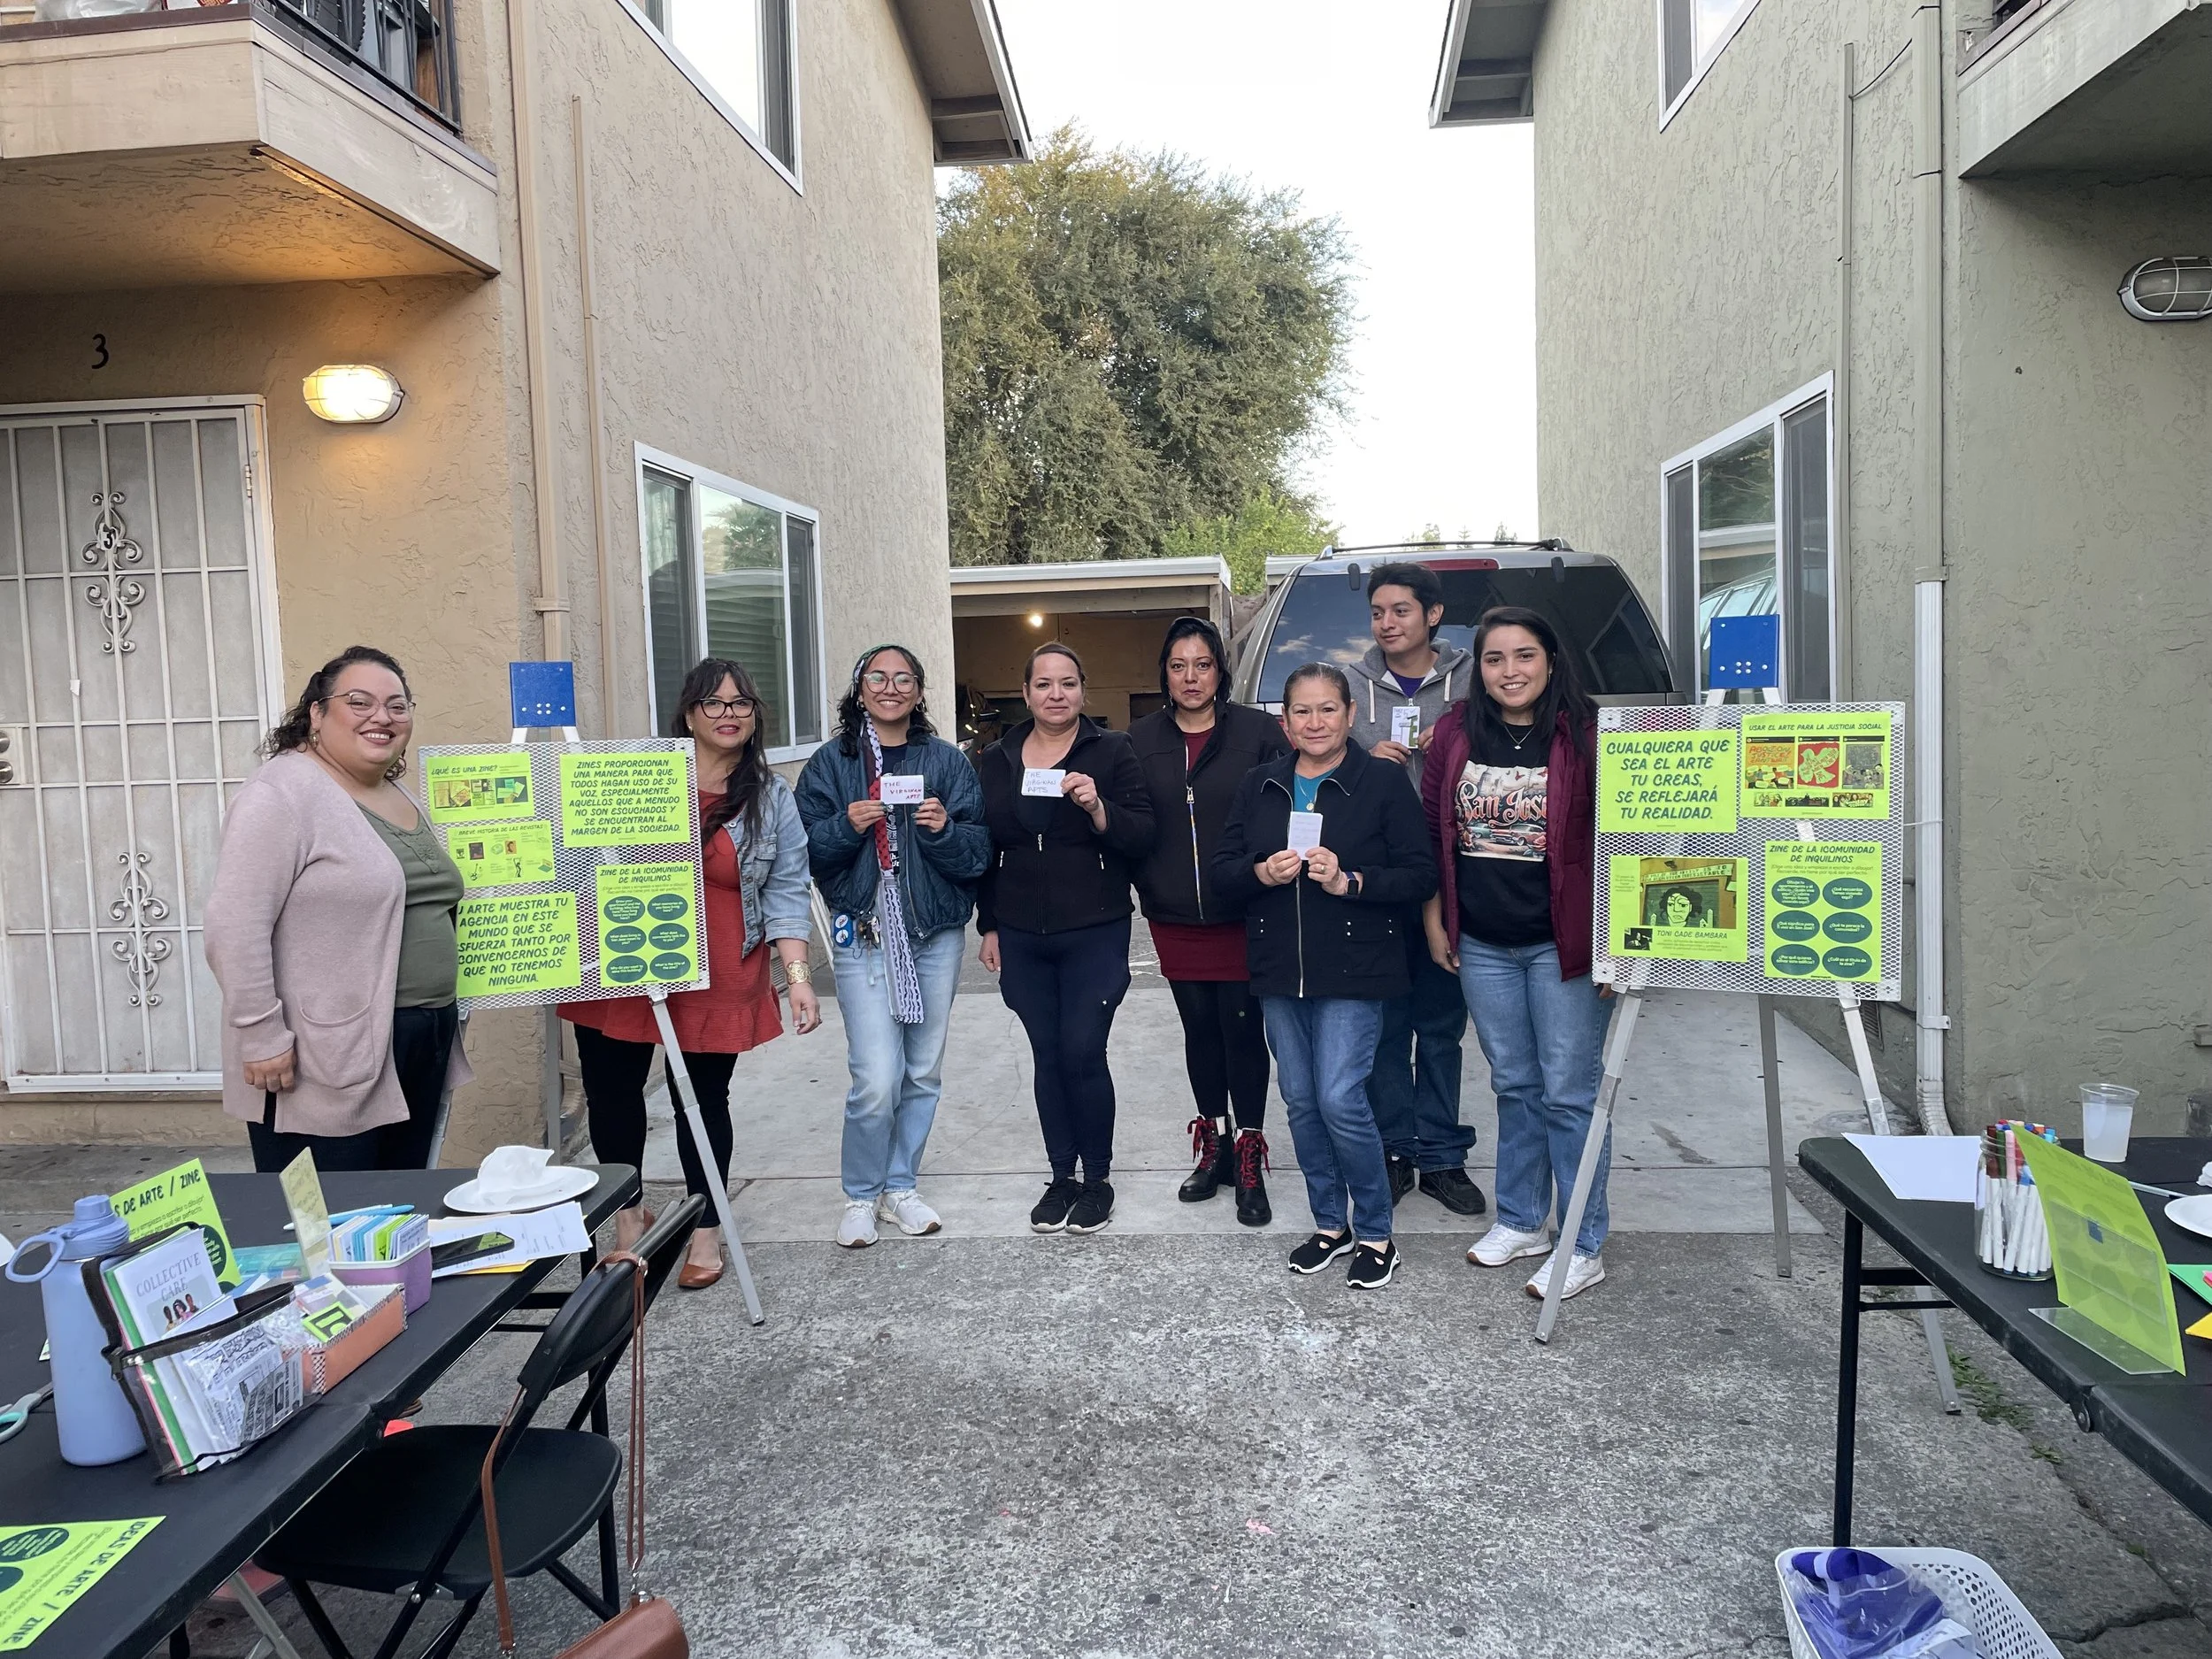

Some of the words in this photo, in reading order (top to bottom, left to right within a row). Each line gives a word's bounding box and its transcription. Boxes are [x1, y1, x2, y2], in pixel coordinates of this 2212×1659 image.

[91, 333, 109, 369] 3
[1607, 741, 1693, 756] CUALQUIERA
[1700, 739, 1730, 754] QUE
[431, 766, 449, 776] ¿QUÉ
[604, 759, 669, 768] PROPORCIONAN
[1621, 758, 1647, 770] SEA
[1654, 758, 1670, 770] EL
[1676, 757, 1714, 769] ARTE
[1631, 775, 1648, 786] TU
[1653, 773, 1702, 787] CREAS,
[601, 787, 669, 796] ESPECIALMENTE
[1615, 791, 1634, 803] SE
[1639, 785, 1718, 803] REFLEJARÁ
[569, 799, 613, 807] AQUELLOS
[616, 798, 634, 806] QUE
[1455, 780, 1500, 826] San
[611, 806, 667, 815] ESCUCHADOS
[1621, 807, 1637, 819] TU
[1642, 807, 1713, 819] REALIDAD.
[599, 816, 654, 824] ENCUENTRAN
[571, 827, 607, 835] MARGEN
[638, 824, 680, 833] SOCIEDAD.
[1820, 846, 1875, 854] ICOMUNIDAD
[1805, 855, 1853, 863] INQUILINOS
[467, 903, 495, 914] ARTE
[500, 899, 550, 912] MUESTRA
[555, 898, 568, 906] TU
[460, 915, 508, 927] AGENCIA
[513, 914, 528, 922] EN
[532, 910, 559, 920] ESTE
[468, 927, 508, 939] MUNDO
[513, 925, 535, 936] QUE
[539, 923, 553, 932] SE
[457, 939, 506, 952] SFUERZA
[511, 936, 545, 946] TANTO
[549, 934, 571, 944] POR
[458, 948, 548, 965] CONVENCERNOS
[552, 946, 567, 955] DE
[464, 966, 486, 977] QUE
[491, 964, 506, 973] NO
[512, 959, 562, 972] TENEMOS
[488, 974, 538, 986] NINGUNA.
[124, 1197, 136, 1215] DE
[140, 1185, 164, 1207] ARTE
[180, 1169, 200, 1189] ZINE
[136, 1252, 201, 1297] COLLECTIVE
[161, 1277, 188, 1301] CARE
